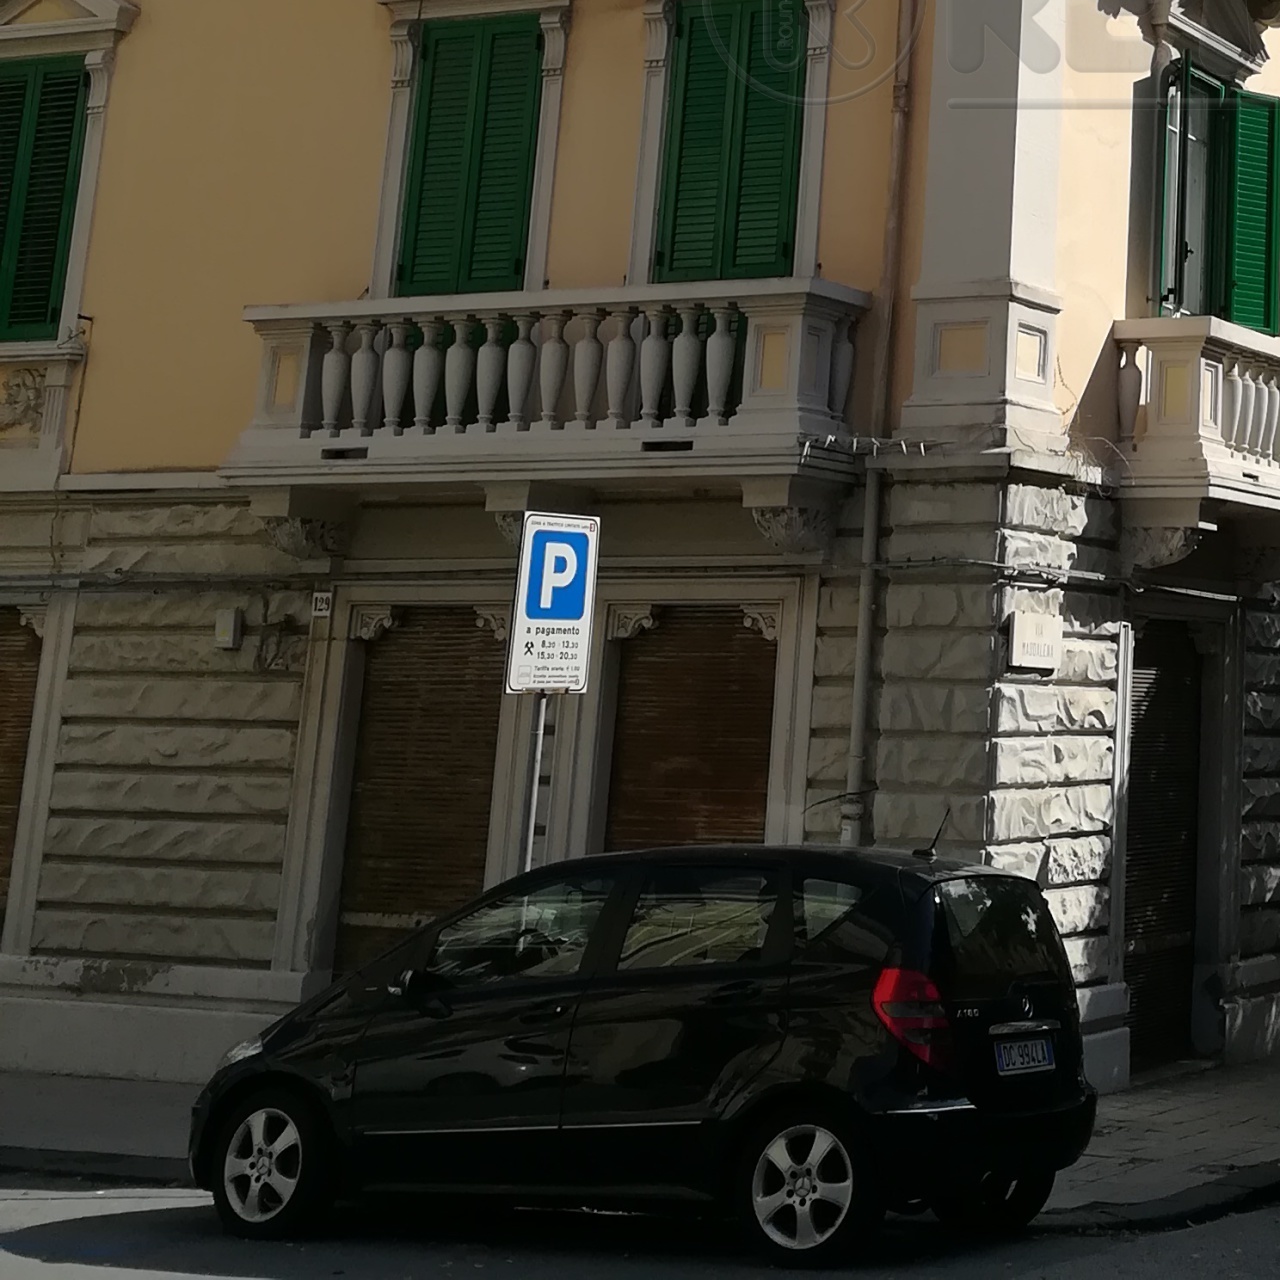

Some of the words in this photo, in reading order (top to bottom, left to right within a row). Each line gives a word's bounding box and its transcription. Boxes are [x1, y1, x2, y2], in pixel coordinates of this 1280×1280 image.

[539, 542, 578, 609] P
[314, 596, 331, 612] 129
[535, 626, 580, 636] pagamento
[1002, 1044, 1017, 1068] DC
[1017, 1041, 1048, 1066] 994LA
